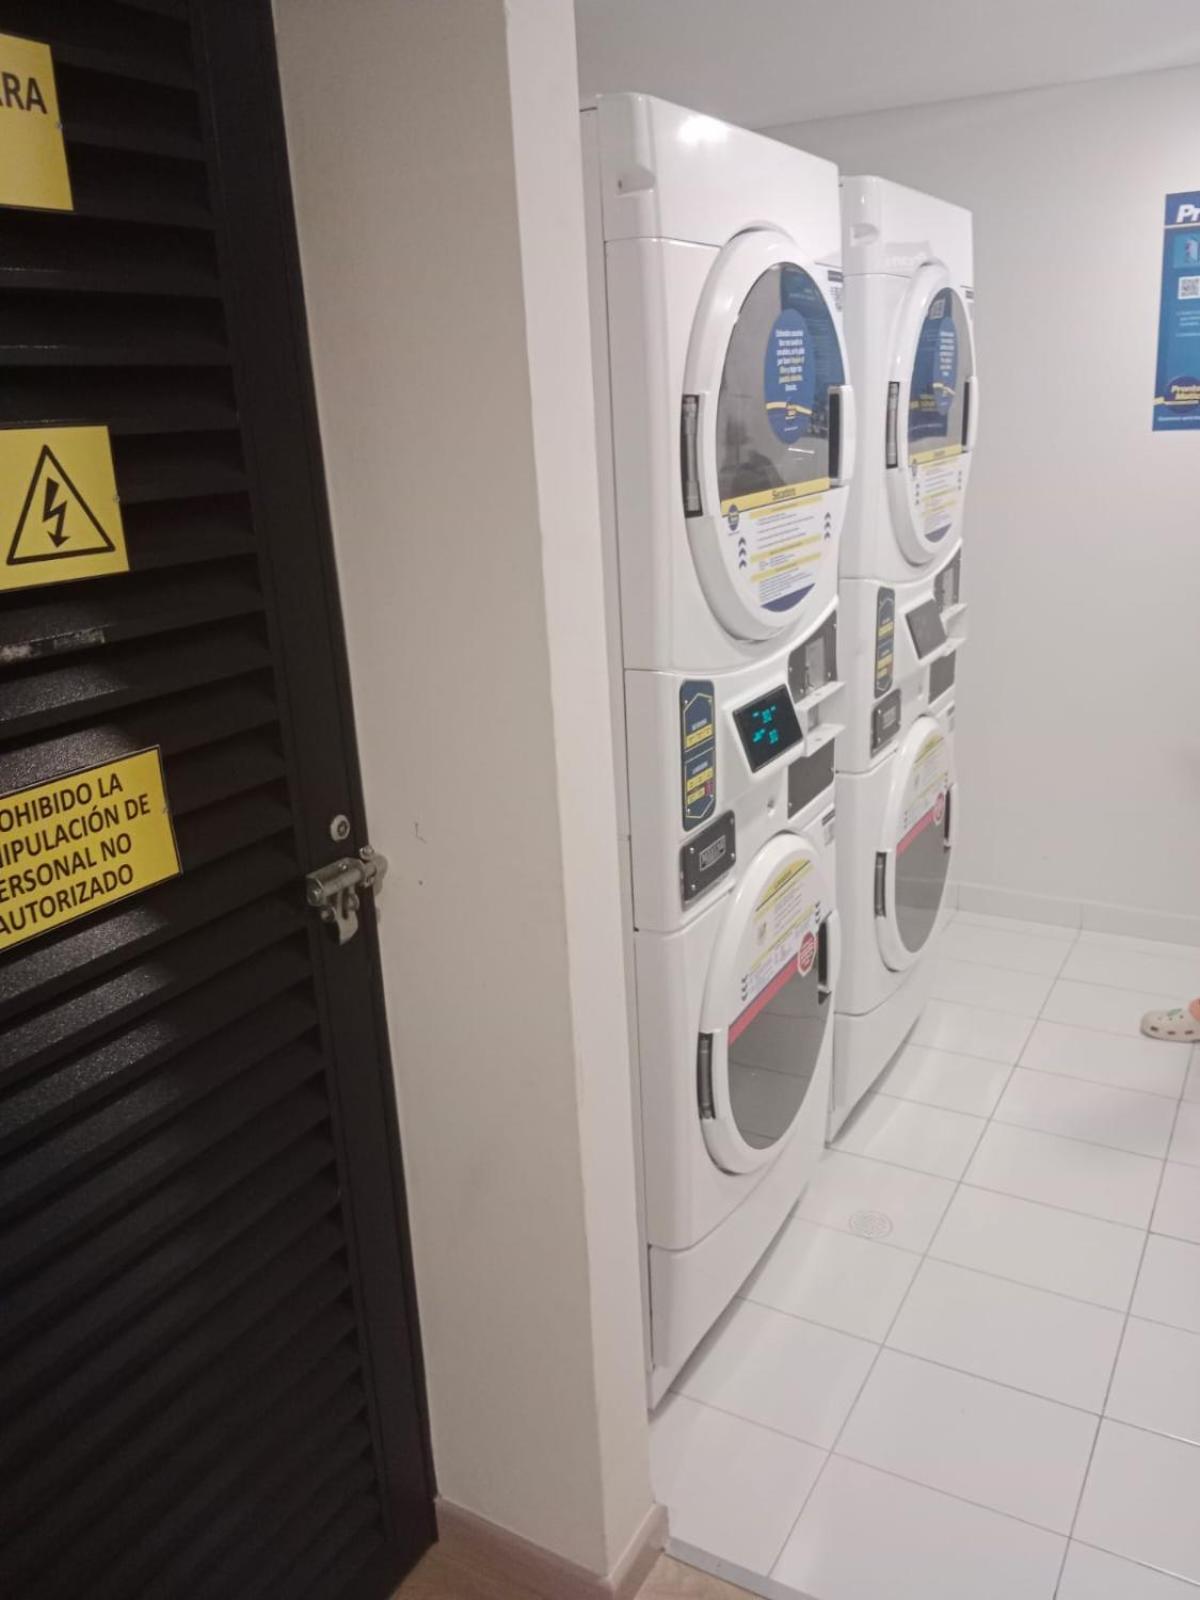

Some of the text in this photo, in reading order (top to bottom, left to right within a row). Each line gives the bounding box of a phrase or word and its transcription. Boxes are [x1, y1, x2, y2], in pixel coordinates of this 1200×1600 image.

[0, 71, 48, 115] RA
[98, 773, 123, 798] LA
[0, 793, 150, 869] IPULACIÓN DE
[100, 833, 131, 862] NO
[0, 863, 133, 936] AUTORIZADO
